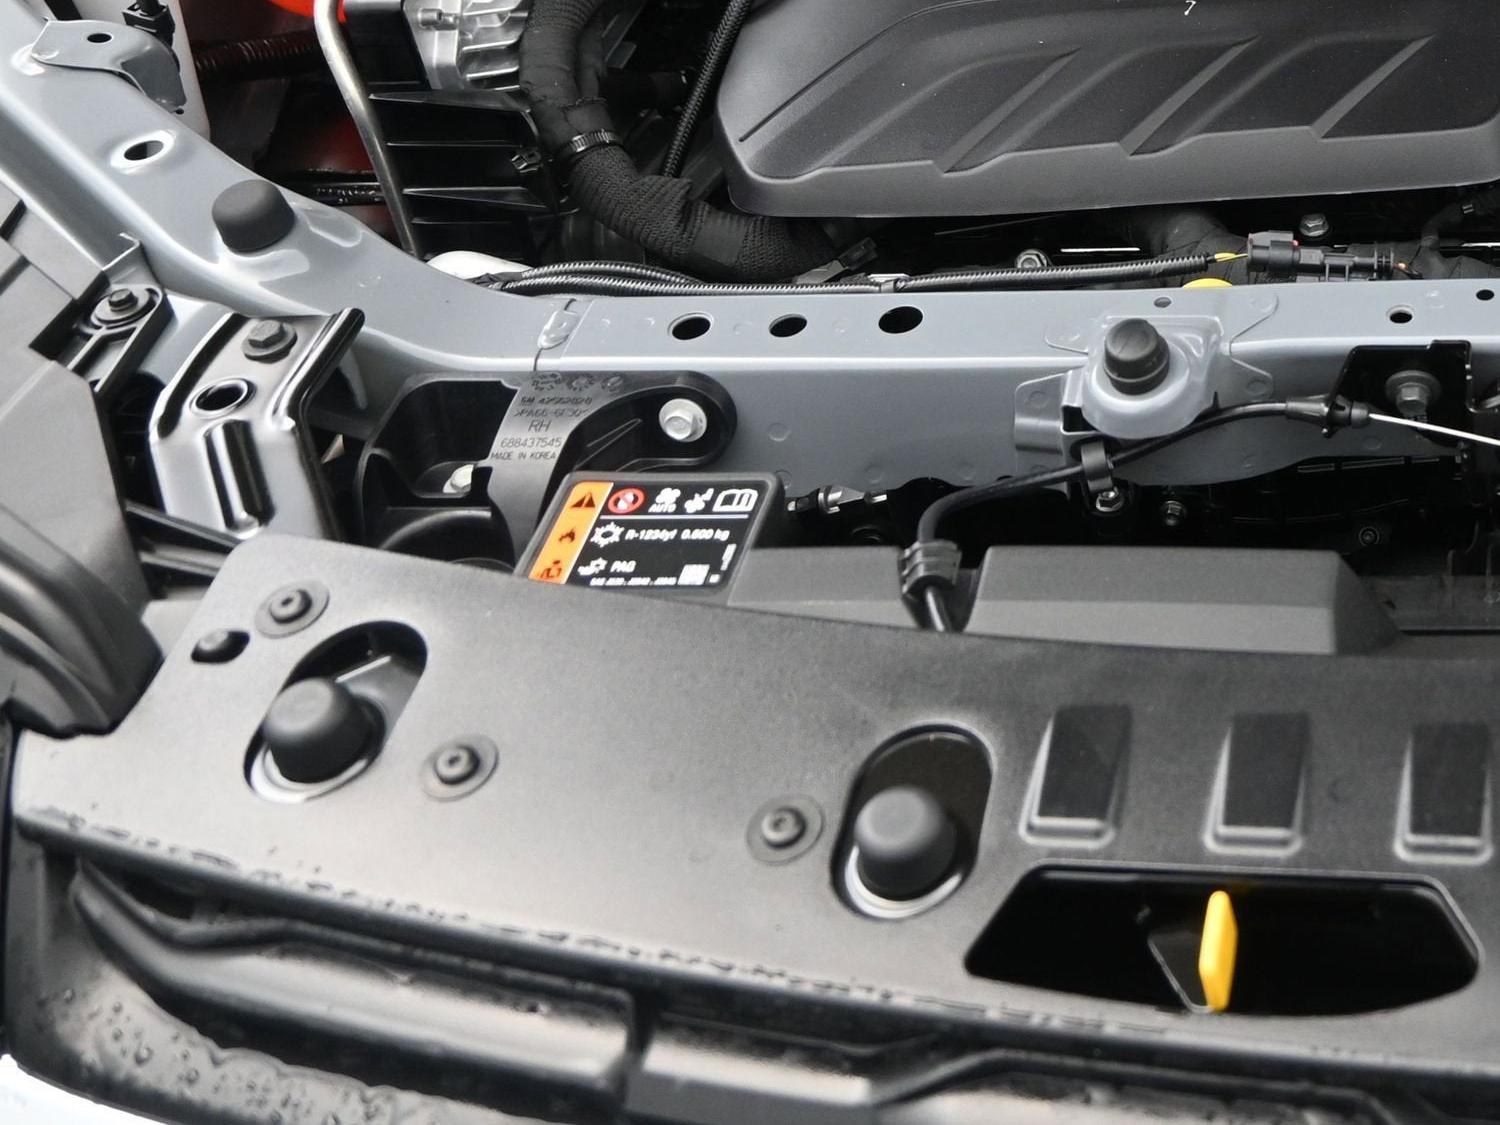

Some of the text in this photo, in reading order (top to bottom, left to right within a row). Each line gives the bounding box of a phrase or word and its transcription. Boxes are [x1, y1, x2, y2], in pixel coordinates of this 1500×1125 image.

[528, 418, 552, 433] RH
[500, 436, 563, 449] 688437545
[490, 450, 557, 461] MADE IN KOREA
[648, 503, 677, 513] AUTO
[714, 528, 730, 542] kg
